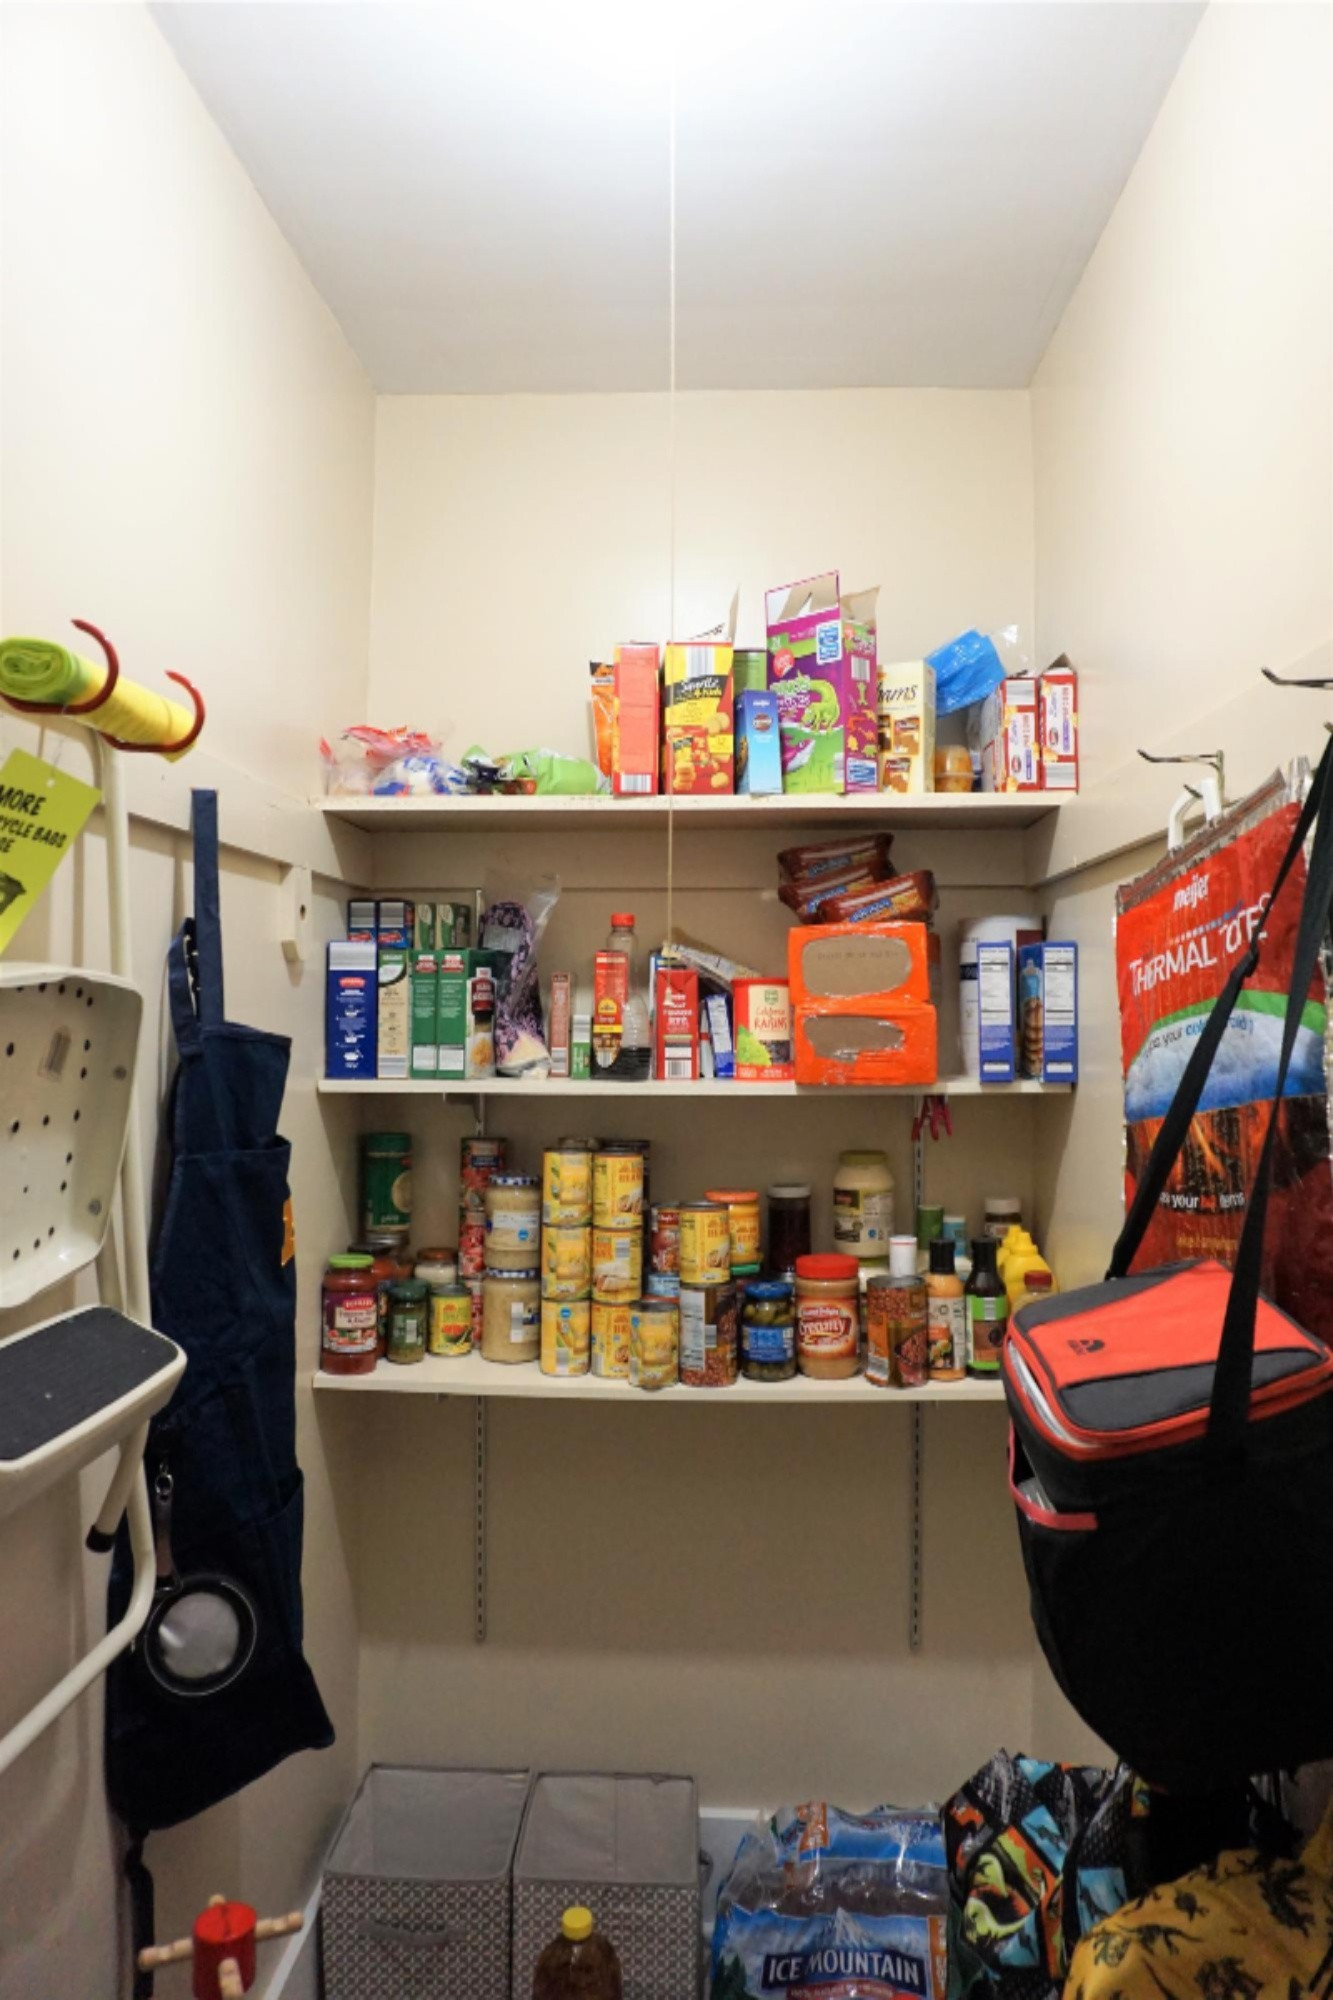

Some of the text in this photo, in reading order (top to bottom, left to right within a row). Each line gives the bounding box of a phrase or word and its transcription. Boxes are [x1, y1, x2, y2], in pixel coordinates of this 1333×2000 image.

[0, 784, 47, 816] MORE
[0, 814, 35, 838] YCLE
[1173, 872, 1210, 913] meijer
[1128, 936, 1218, 997] THERMAL
[1171, 1193, 1199, 1208] your
[768, 1957, 803, 1983] ICE
[805, 1949, 919, 1986] MOUNTAIN
